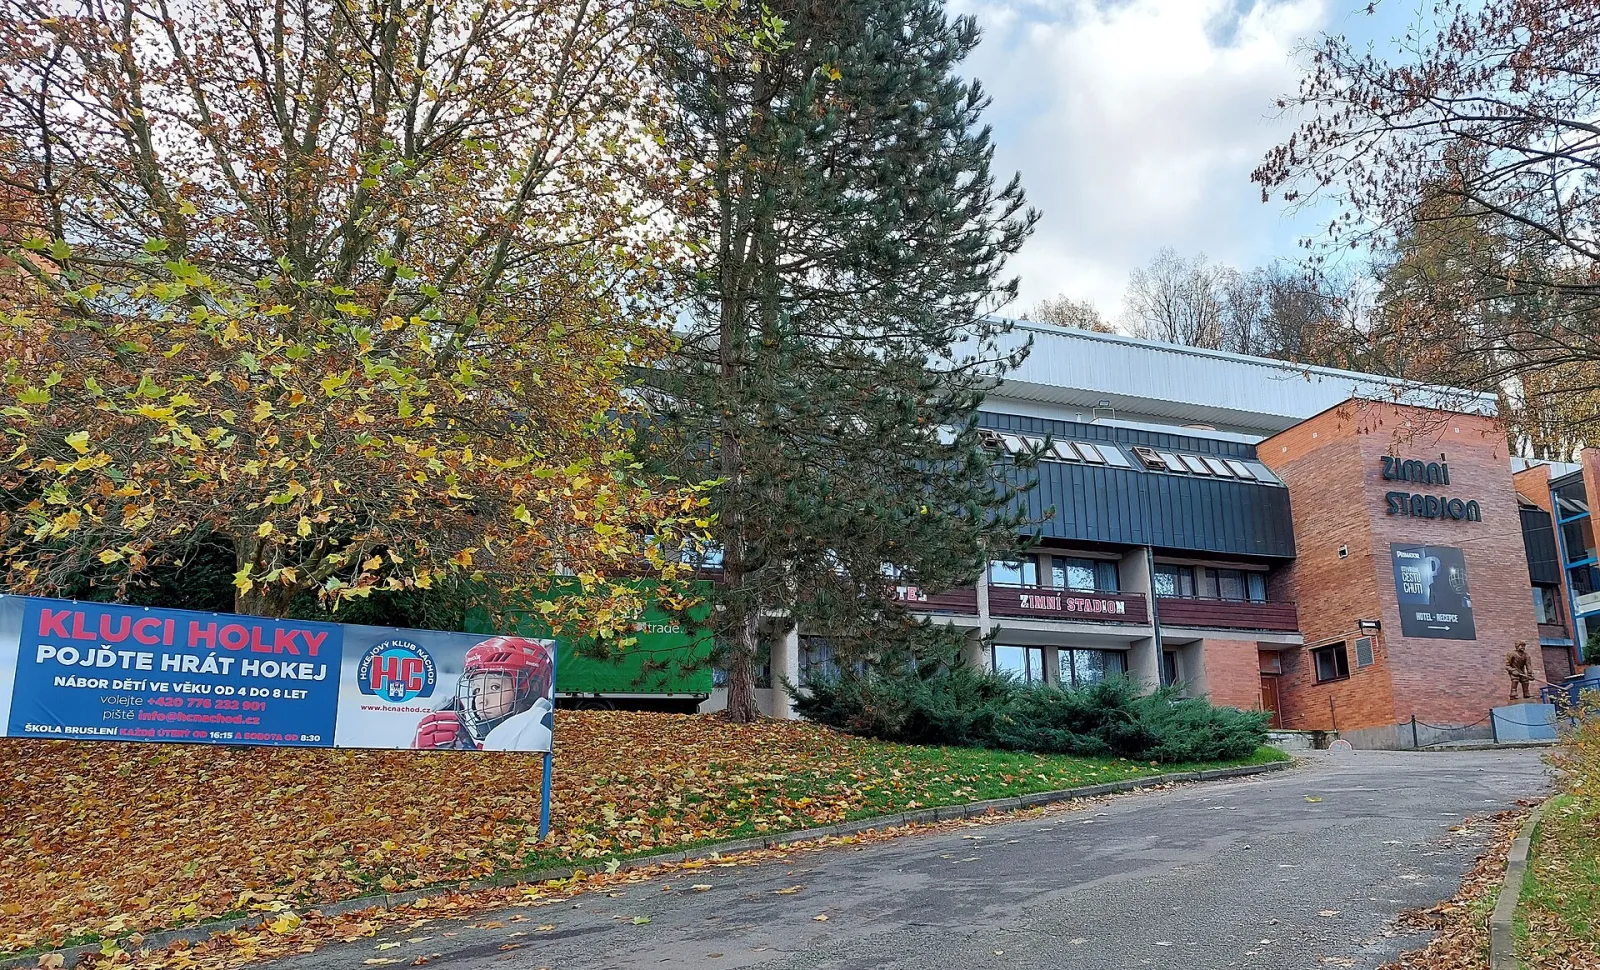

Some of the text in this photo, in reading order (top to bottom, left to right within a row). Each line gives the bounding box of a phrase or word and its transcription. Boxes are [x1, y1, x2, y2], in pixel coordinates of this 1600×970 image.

[1385, 491, 1482, 522] STADION
[1019, 592, 1126, 614] ZIMNÍ STADION
[1416, 612, 1433, 621] HOTEL
[1436, 613, 1459, 623] RECEPCE
[38, 608, 328, 656] KLUCI HOLKY
[36, 644, 328, 681] POJĎTE HRÁT HOKEJ
[360, 640, 434, 685] HOKEJOVÝ KLUB NÁCHOD
[370, 655, 424, 691] HC
[54, 675, 308, 700] NÁBOR DĚTÍ VE VĚKU OD 4 DO 8 LET
[100, 694, 144, 708] volejte
[147, 696, 183, 707] +420
[214, 699, 239, 710] 232
[242, 701, 266, 711] 901
[360, 705, 431, 713] www.hcnachod.cz
[102, 709, 260, 725] piště info@hcnachod.cz
[24, 722, 62, 733] ŠKOLA
[64, 726, 118, 736] BRUSLENÍ
[209, 731, 233, 739] 16:15
[234, 731, 242, 739] A
[300, 734, 321, 742] 8:30
